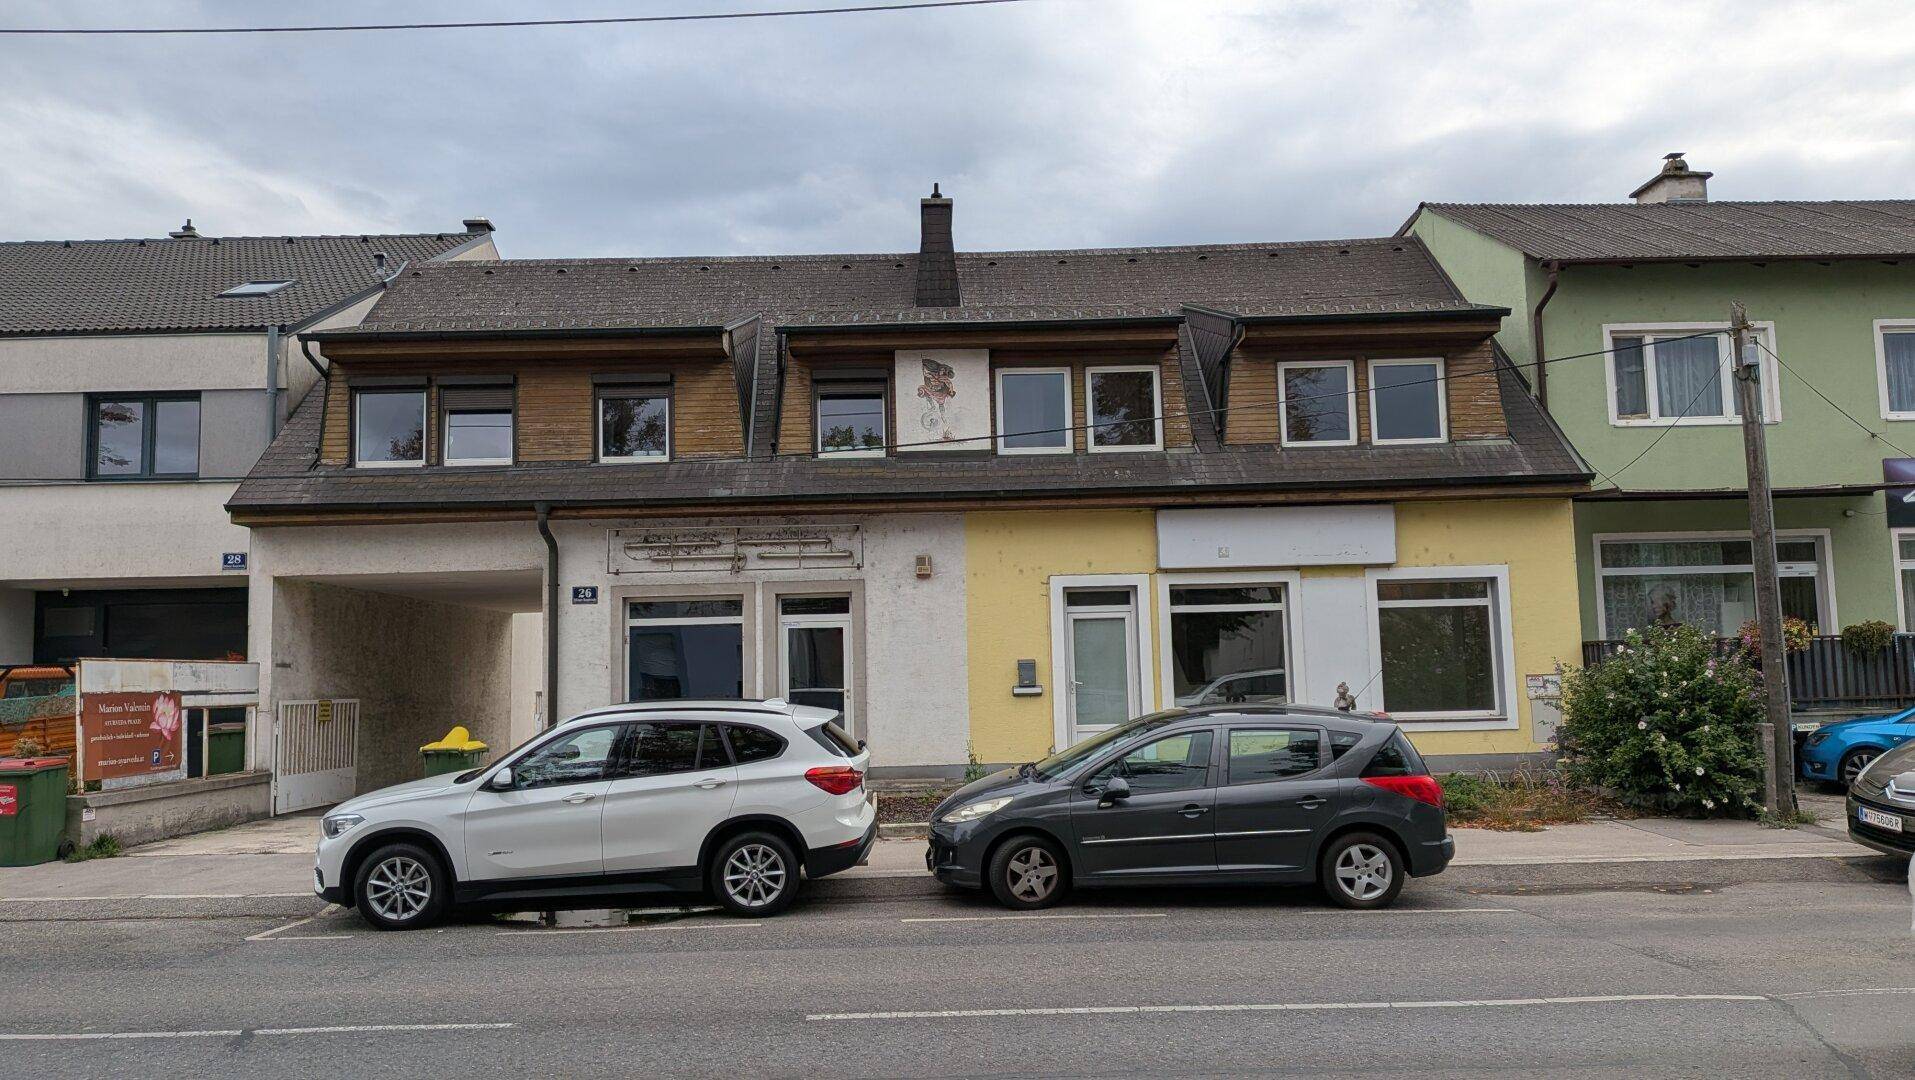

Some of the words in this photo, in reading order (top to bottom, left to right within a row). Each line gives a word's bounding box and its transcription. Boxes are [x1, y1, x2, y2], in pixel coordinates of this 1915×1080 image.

[227, 554, 241, 564] 28
[578, 588, 592, 598] 26
[98, 703, 123, 714] Marion
